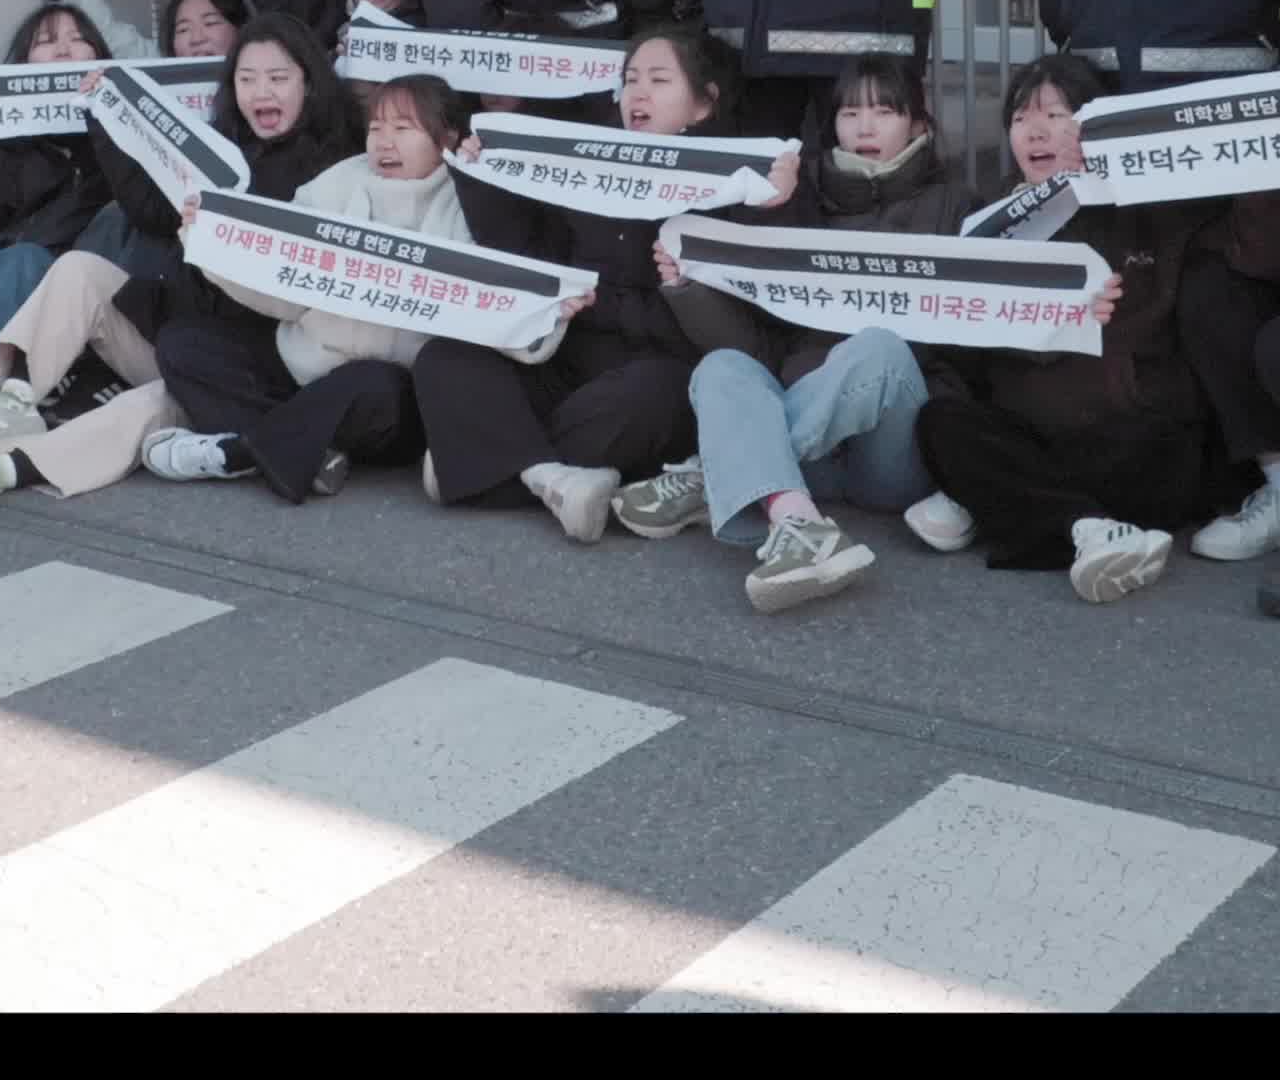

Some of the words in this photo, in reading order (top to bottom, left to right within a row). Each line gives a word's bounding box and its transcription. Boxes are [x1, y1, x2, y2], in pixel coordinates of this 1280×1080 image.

[342, 38, 397, 62] 란대행
[404, 43, 453, 66] 한덕수
[460, 47, 512, 73] 지지한
[519, 55, 573, 80] 미국은
[7, 76, 50, 93] 대학생
[1174, 102, 1234, 126] 대학생
[1239, 96, 1278, 119] 면담
[572, 140, 615, 160] 대학생
[618, 146, 644, 163] 면담
[647, 148, 680, 167] 요청
[1120, 144, 1204, 177] 한덕수
[531, 163, 588, 188] 한덕수
[594, 172, 653, 202] 지지한
[315, 223, 361, 248] 대학생
[363, 234, 392, 256] 면담
[395, 242, 428, 265] 요청
[215, 223, 274, 256] 이재명
[280, 238, 337, 273] 대표를
[344, 255, 403, 289] 범죄인
[408, 272, 470, 306] 취급한
[476, 289, 517, 314] 발언
[810, 254, 861, 271] 대학생
[864, 257, 898, 274] 면담
[903, 259, 936, 277] 요청
[277, 265, 356, 304] 취소하고
[360, 290, 441, 322] 사과하라
[765, 282, 834, 308] 한덕수
[842, 288, 912, 316] 지지한
[920, 293, 988, 322] 미국은
